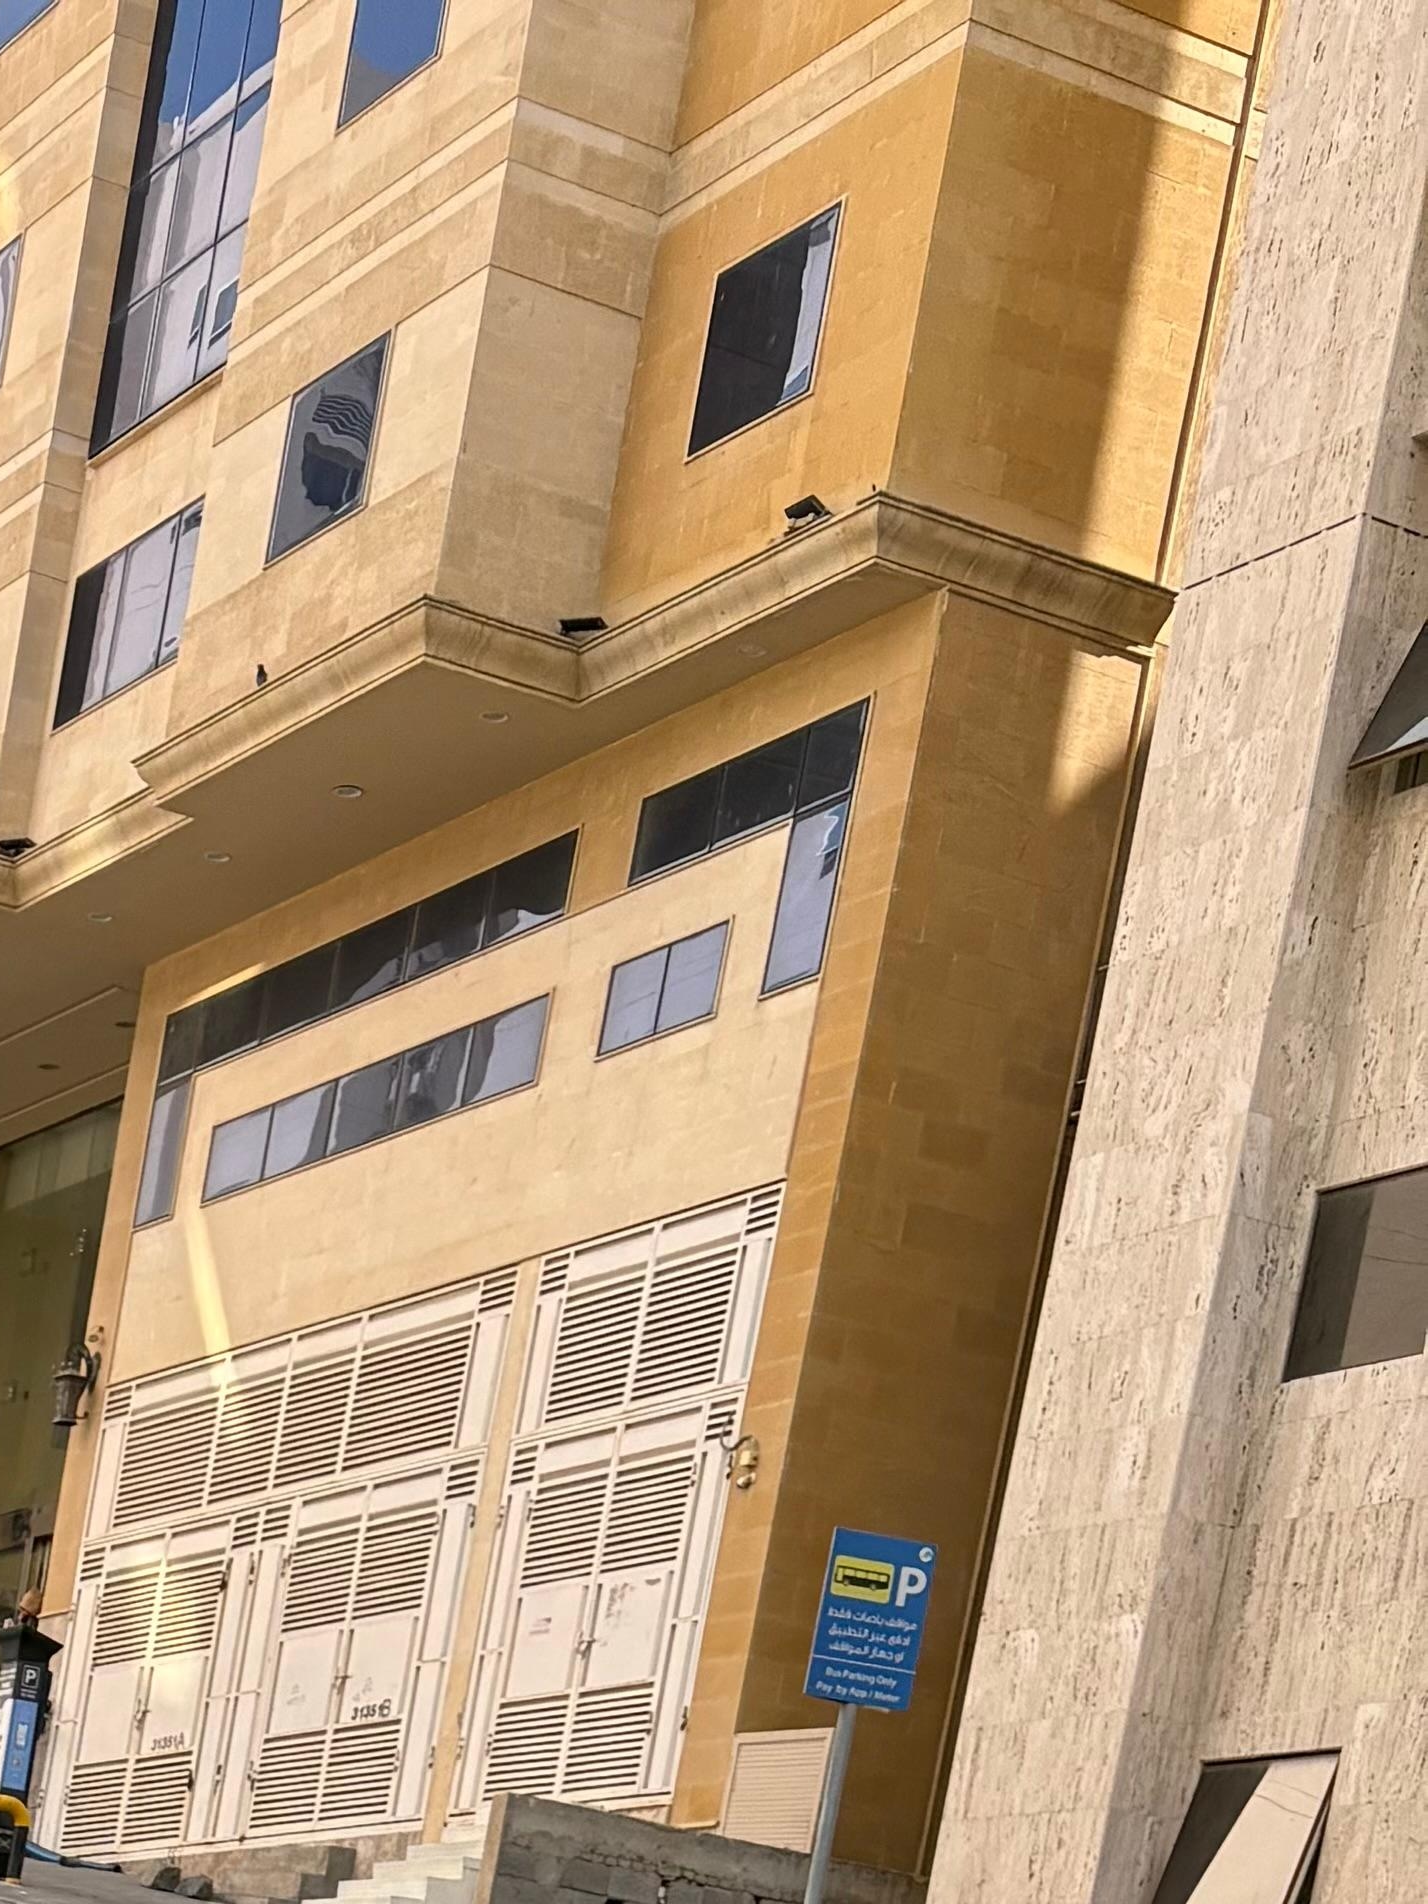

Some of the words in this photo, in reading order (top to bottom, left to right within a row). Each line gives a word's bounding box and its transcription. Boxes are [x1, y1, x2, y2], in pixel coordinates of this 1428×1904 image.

[895, 1566, 928, 1607] P
[827, 1606, 851, 1619] فقط
[852, 1611, 885, 1626] باصات
[828, 1623, 870, 1639] التطبيق
[884, 1617, 918, 1632] مواقف
[868, 1631, 887, 1643] عبر
[887, 1635, 911, 1647] ادفع
[828, 1640, 870, 1656] المواقف
[25, 1669, 37, 1684] P
[825, 1666, 841, 1677] Bus
[842, 1668, 875, 1685] Parking
[875, 1675, 898, 1689] Only
[815, 1681, 834, 1693] Pay
[835, 1684, 847, 1695] by
[847, 1687, 868, 1698] App
[873, 1690, 901, 1703] Meter
